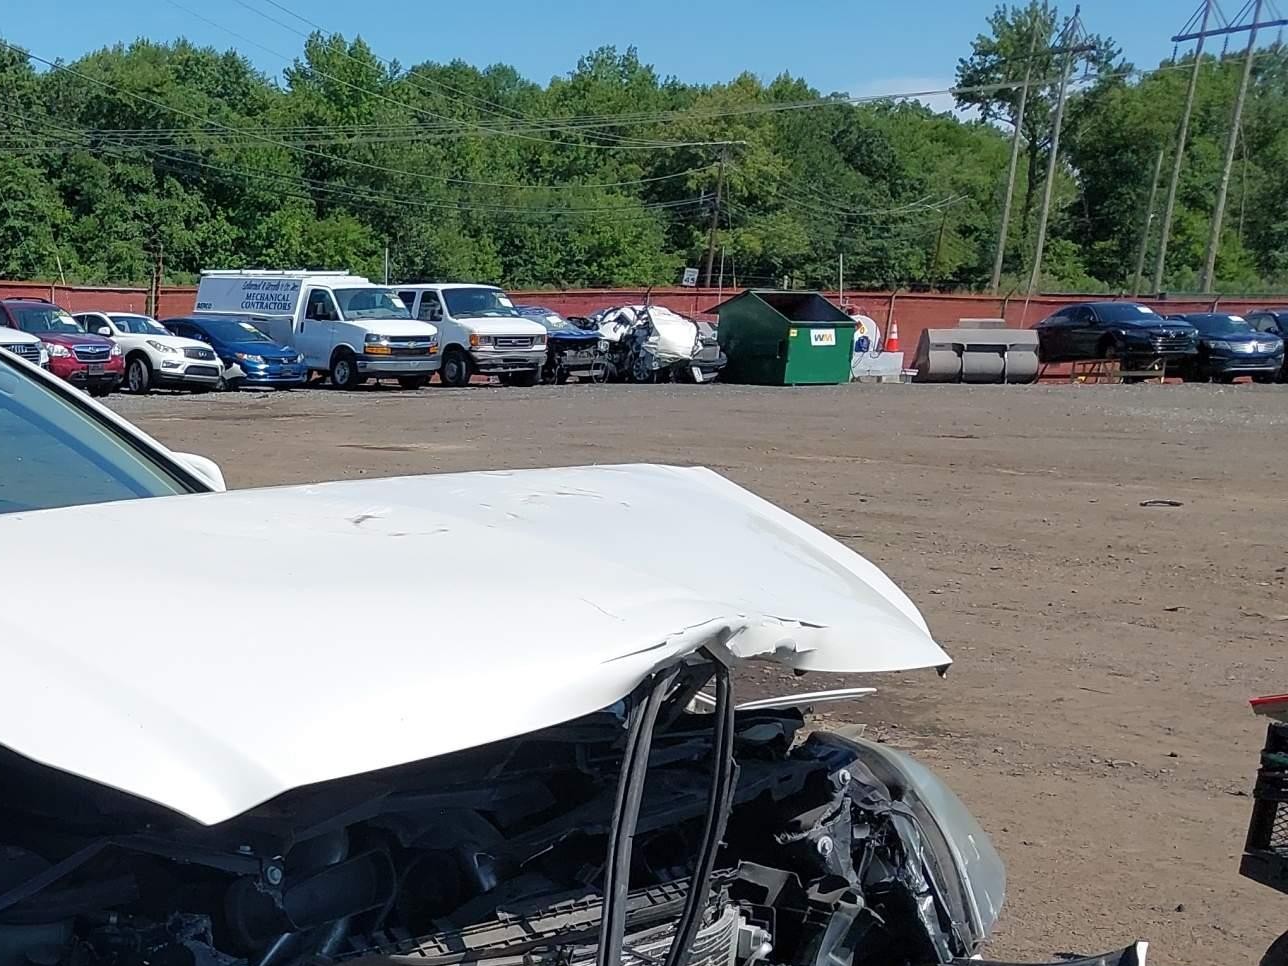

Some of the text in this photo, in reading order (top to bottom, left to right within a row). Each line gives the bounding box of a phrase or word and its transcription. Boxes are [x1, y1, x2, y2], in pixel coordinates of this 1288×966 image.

[245, 292, 291, 302] MECHANICAL
[240, 301, 292, 310] CONTRACTORS
[814, 333, 833, 342] WM
